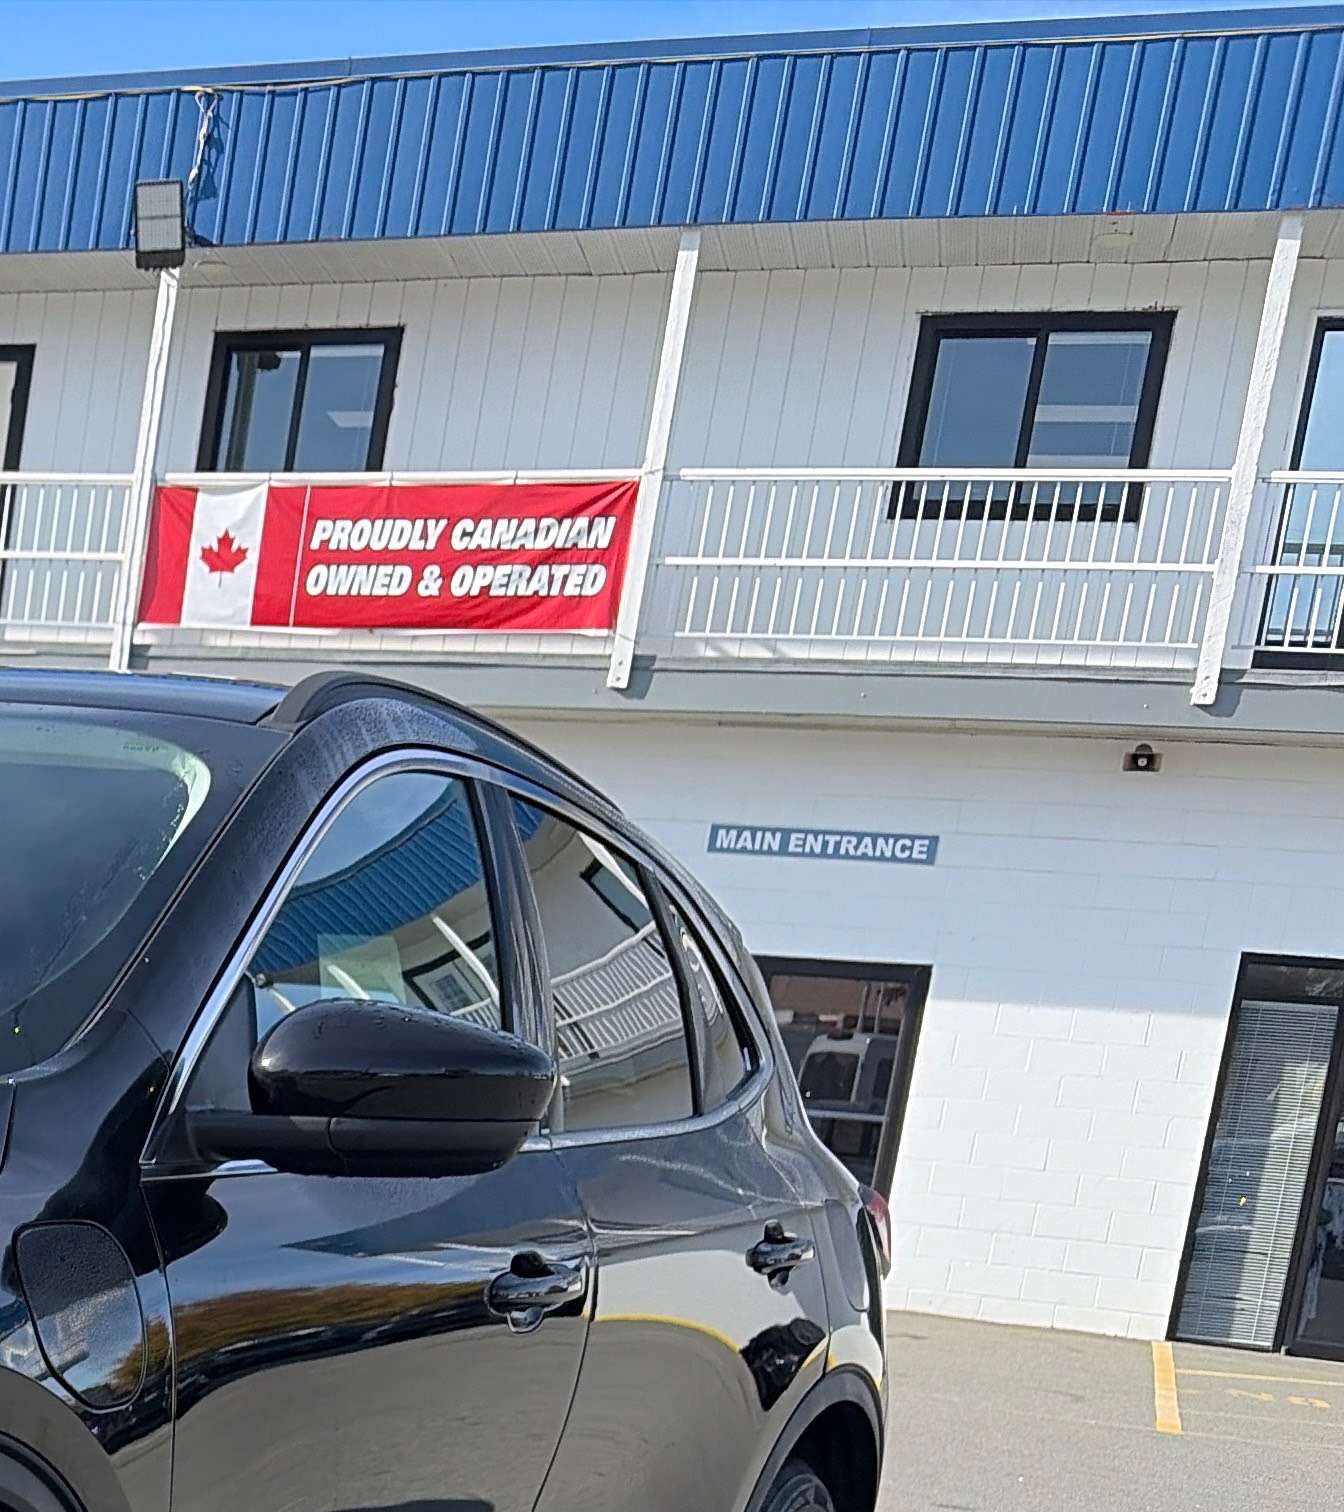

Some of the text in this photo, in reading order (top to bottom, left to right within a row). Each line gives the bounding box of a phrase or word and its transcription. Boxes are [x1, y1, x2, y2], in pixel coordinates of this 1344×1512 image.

[309, 515, 617, 552] PROUDLY CANADIAN
[305, 563, 607, 598] OWNED & OPERATED
[715, 828, 929, 860] MAIN ENTRANCE
